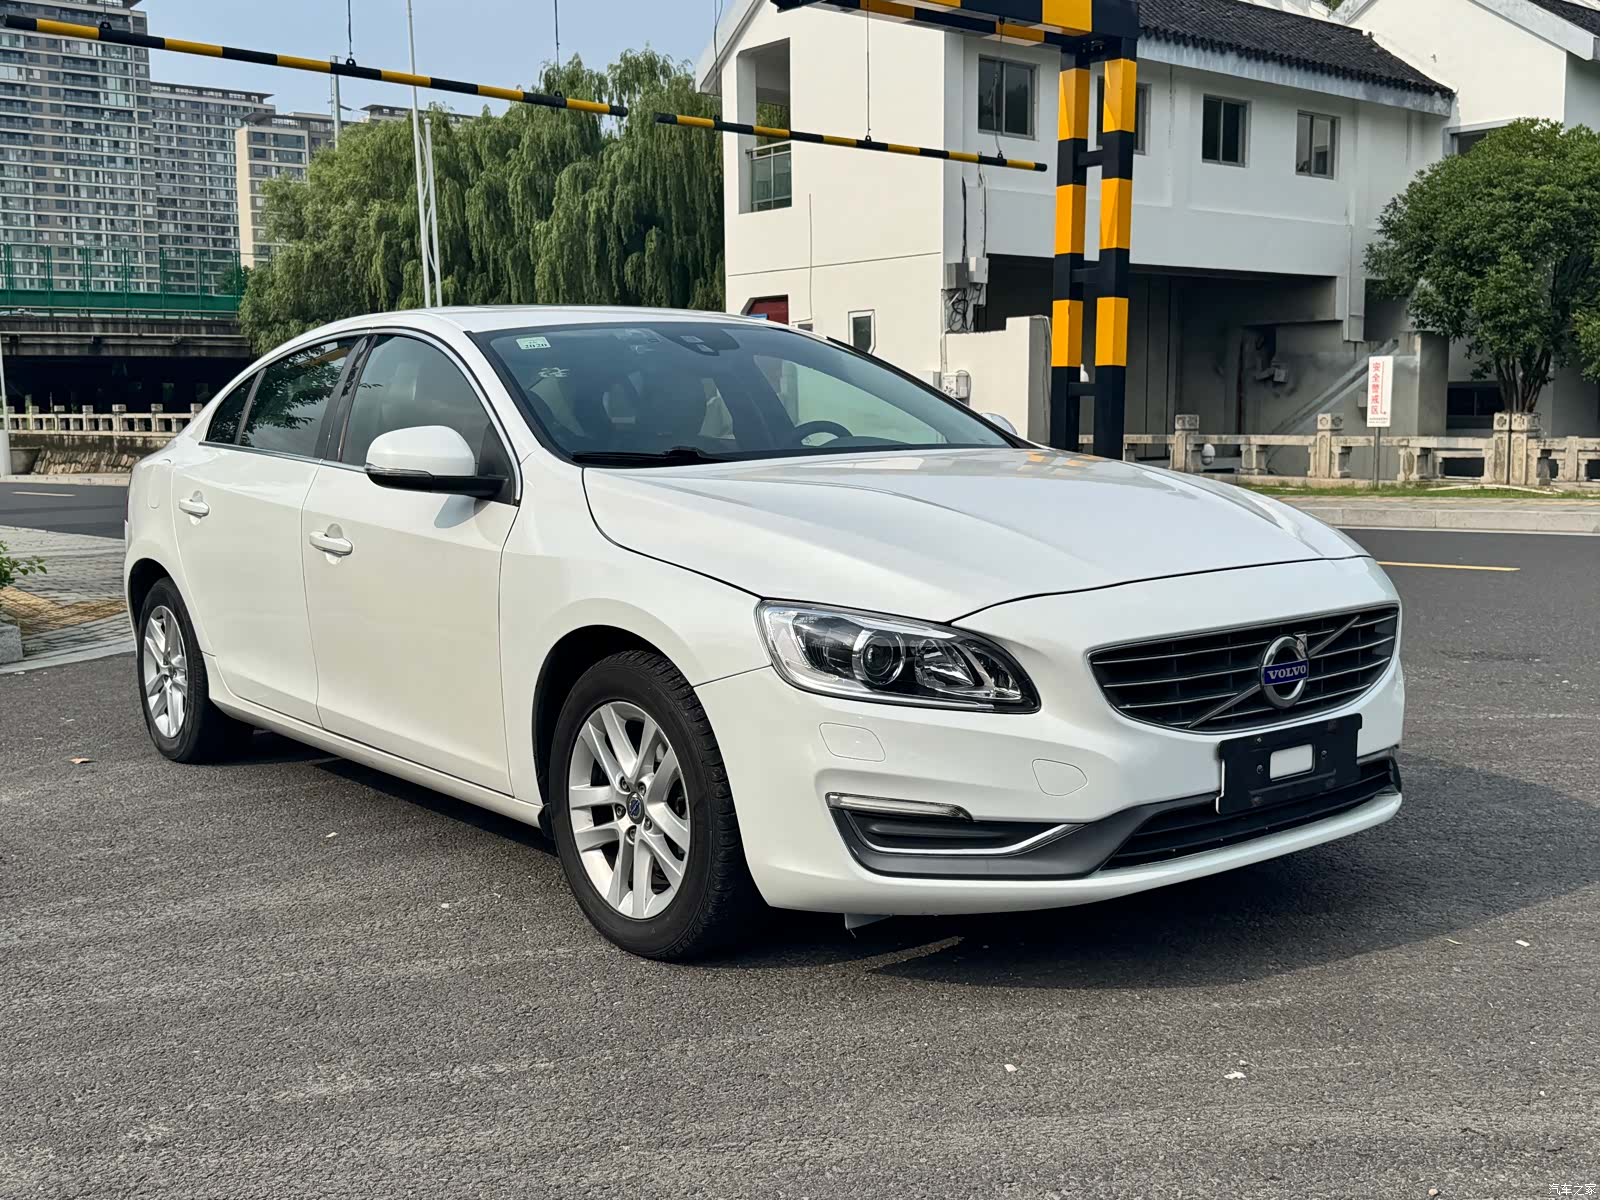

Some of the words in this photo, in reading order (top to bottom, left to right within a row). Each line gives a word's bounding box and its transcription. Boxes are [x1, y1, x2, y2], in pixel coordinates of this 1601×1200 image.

[1371, 361, 1381, 415] 安全警戒区
[1267, 664, 1307, 680] VOLVO
